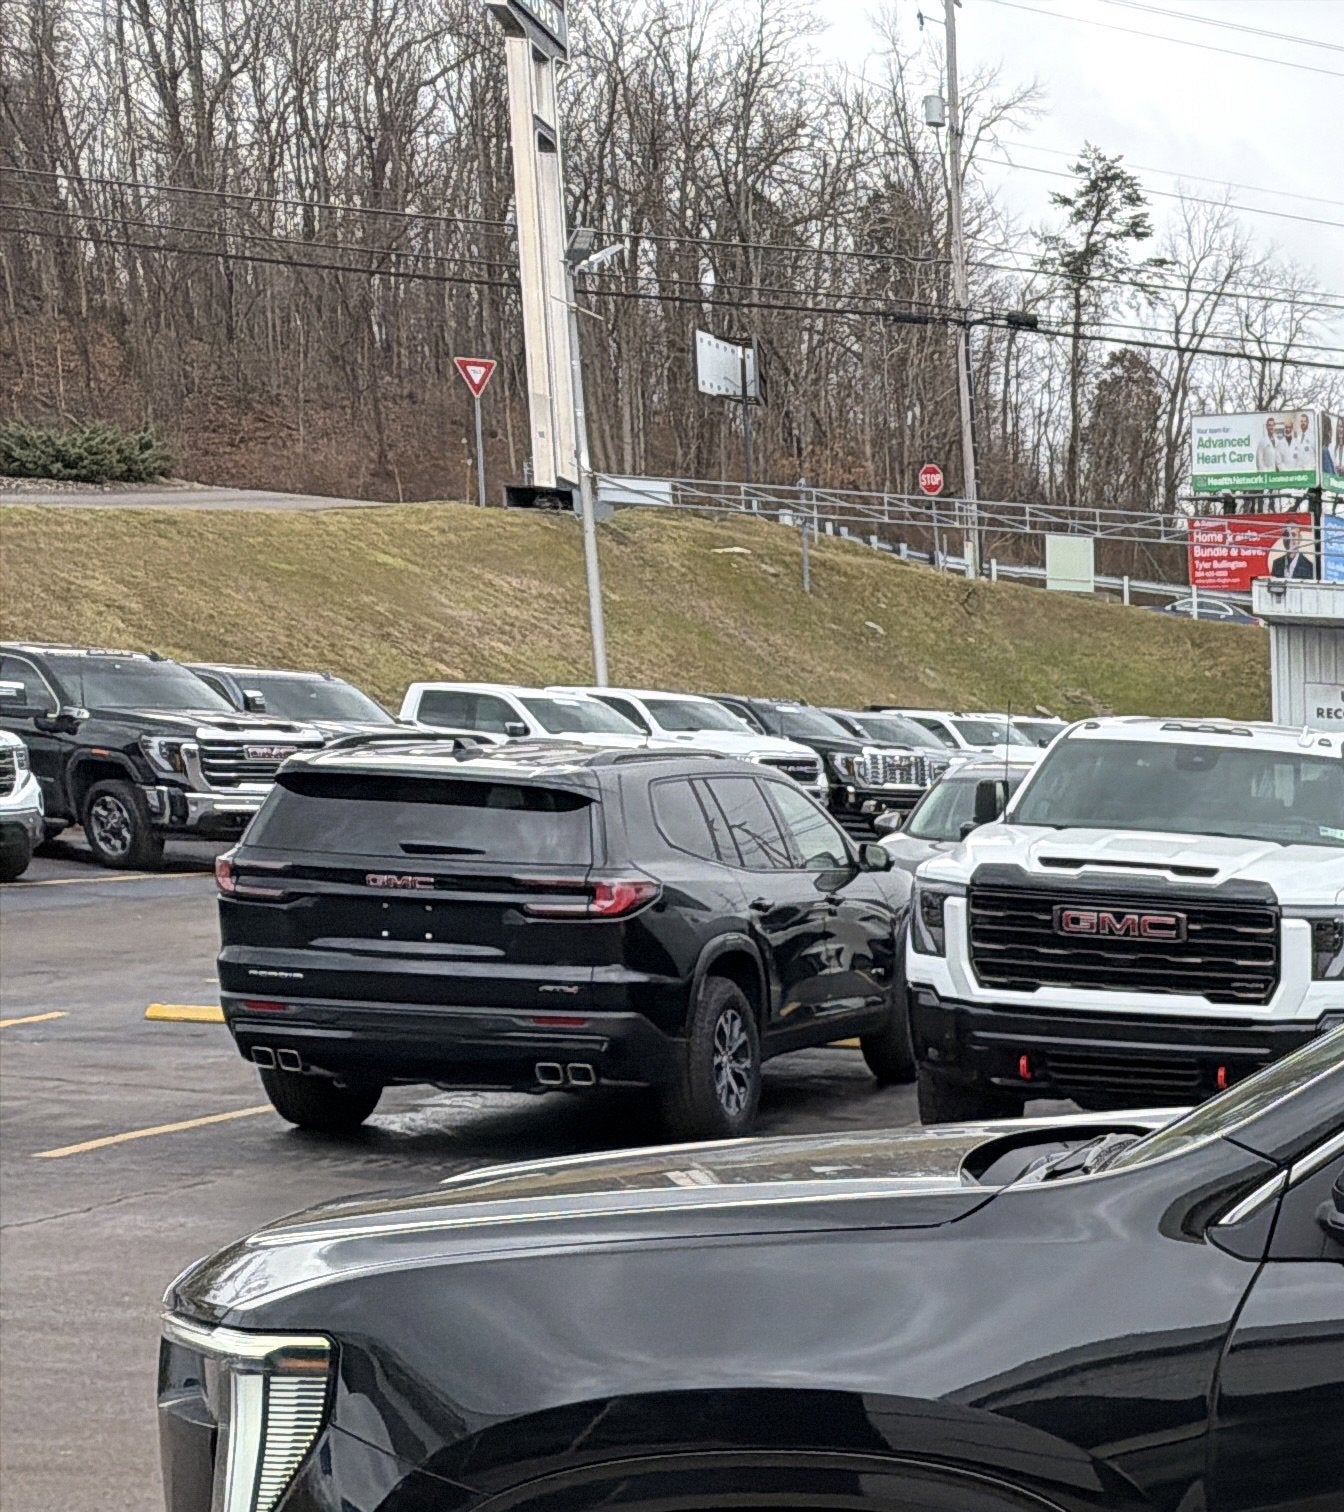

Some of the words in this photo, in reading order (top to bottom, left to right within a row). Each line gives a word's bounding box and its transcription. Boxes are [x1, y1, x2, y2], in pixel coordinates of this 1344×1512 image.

[1196, 434, 1251, 450] Advanced
[1196, 451, 1227, 465] Heart
[1229, 449, 1255, 464] Care
[921, 473, 941, 486] STOP
[1193, 529, 1224, 543] Home
[1193, 545, 1229, 558] Bundle
[366, 873, 434, 890] GMC
[1061, 910, 1177, 938] GMC
